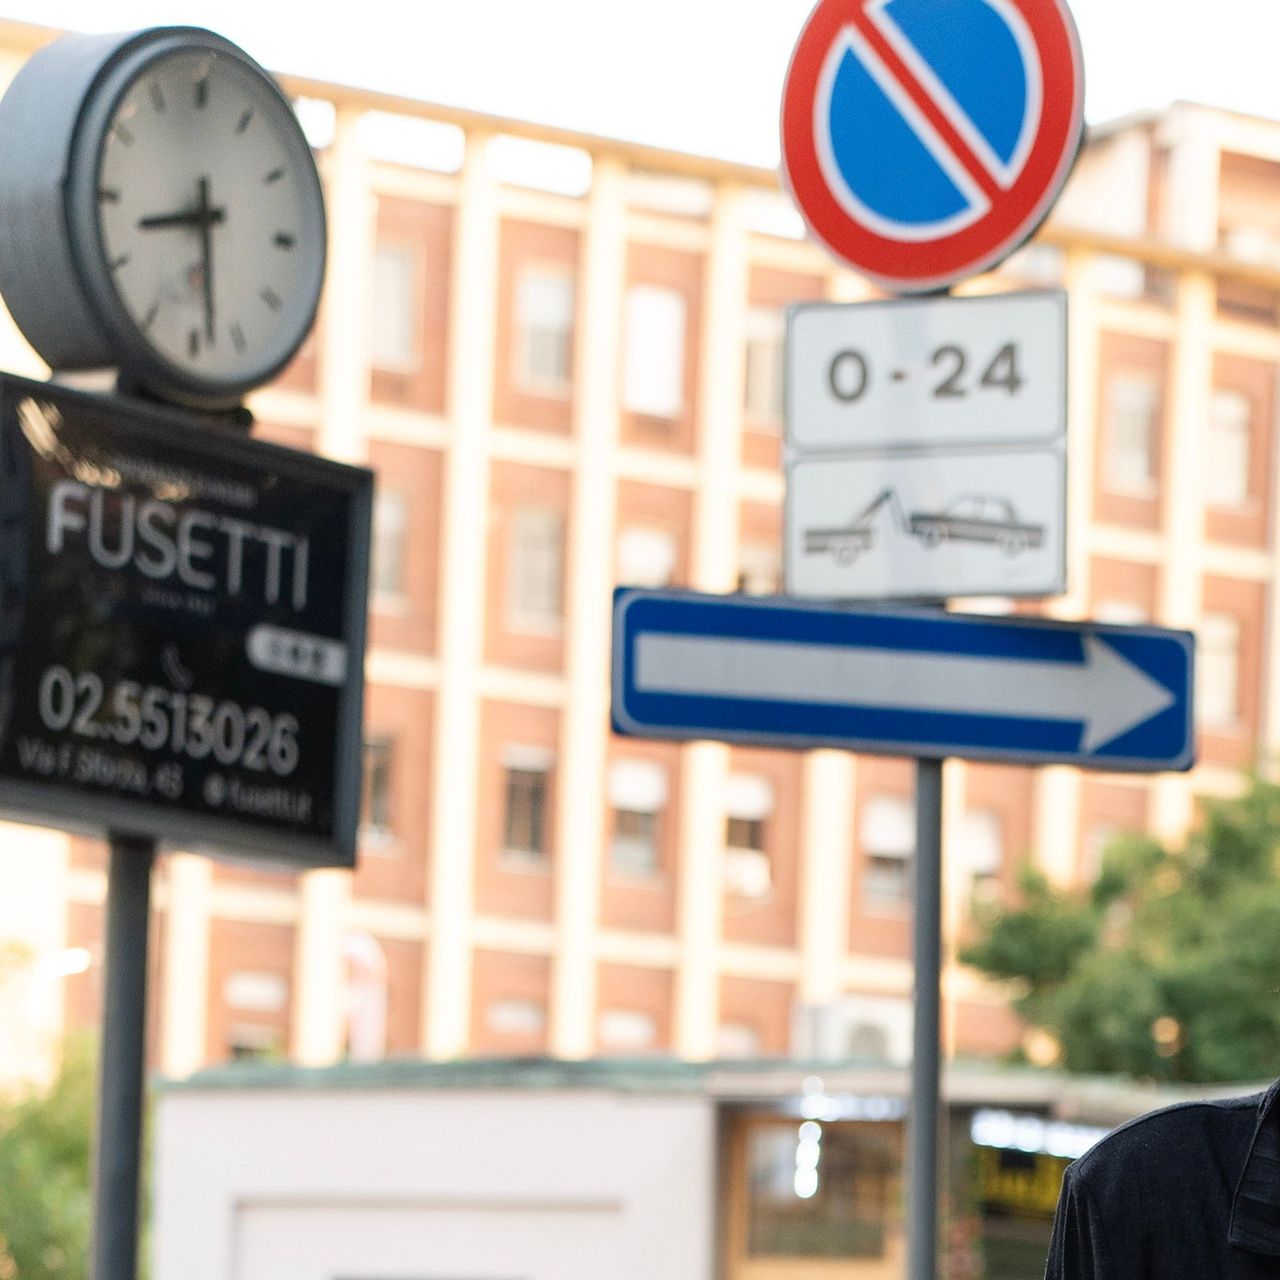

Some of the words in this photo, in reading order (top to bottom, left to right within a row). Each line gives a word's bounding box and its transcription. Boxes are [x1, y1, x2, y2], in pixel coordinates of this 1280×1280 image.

[827, 350, 869, 403] 0
[930, 343, 1024, 398] 24
[45, 479, 311, 614] FUSETTI
